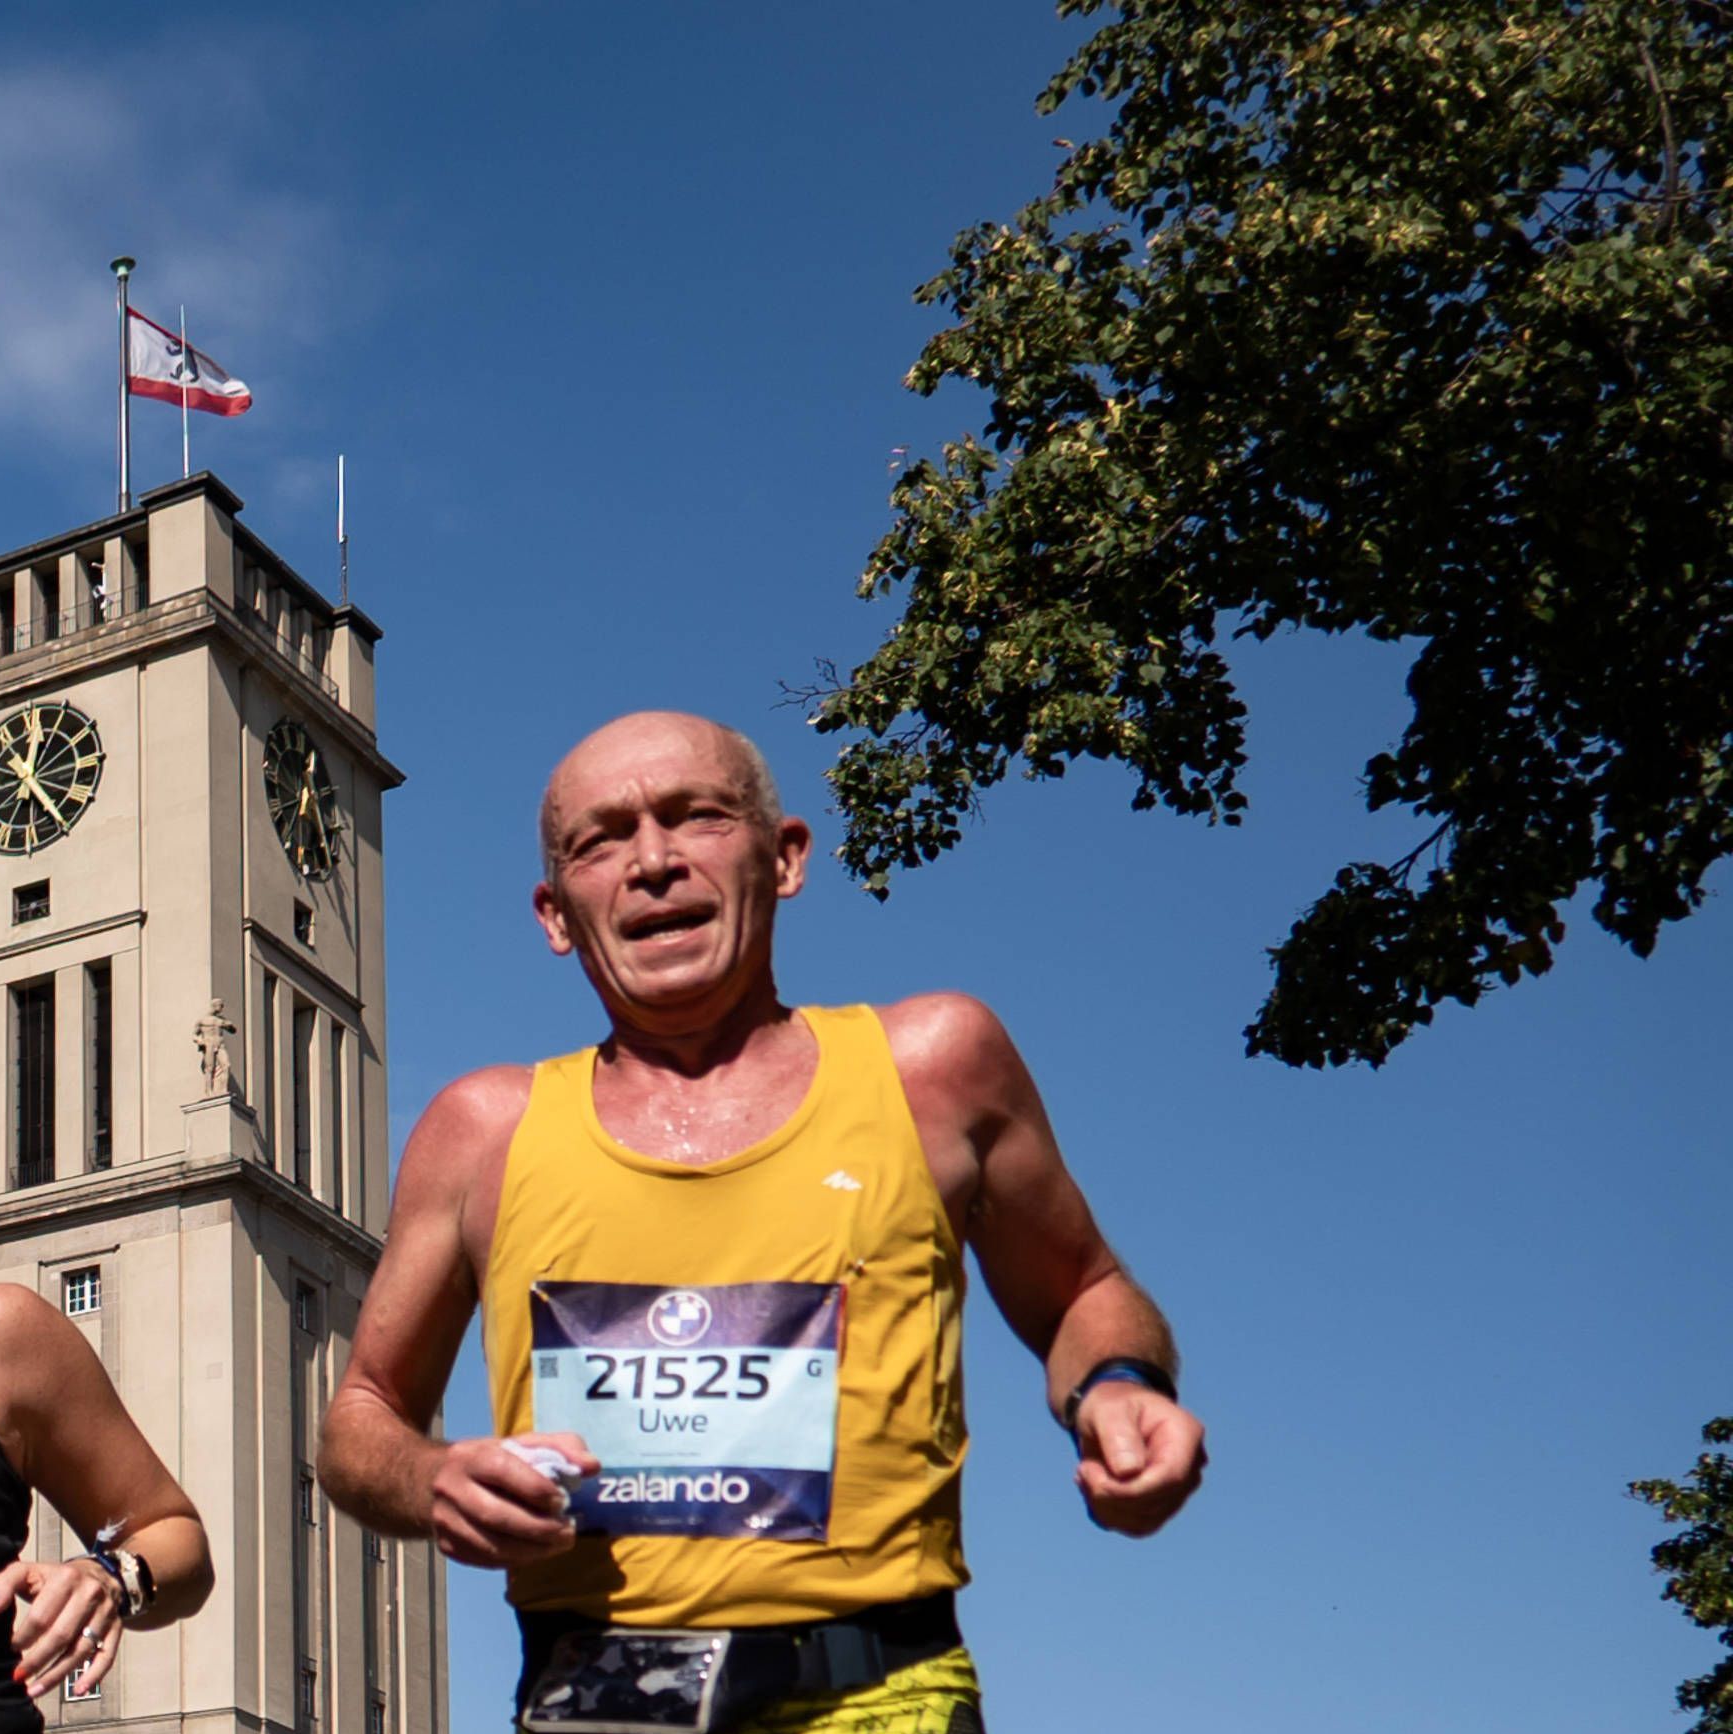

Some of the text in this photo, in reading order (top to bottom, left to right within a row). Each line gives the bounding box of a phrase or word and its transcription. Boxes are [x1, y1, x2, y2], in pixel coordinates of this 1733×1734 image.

[585, 1354, 823, 1401] 21525 G
[638, 1407, 709, 1433] Uwe
[597, 1471, 750, 1504] zalando
